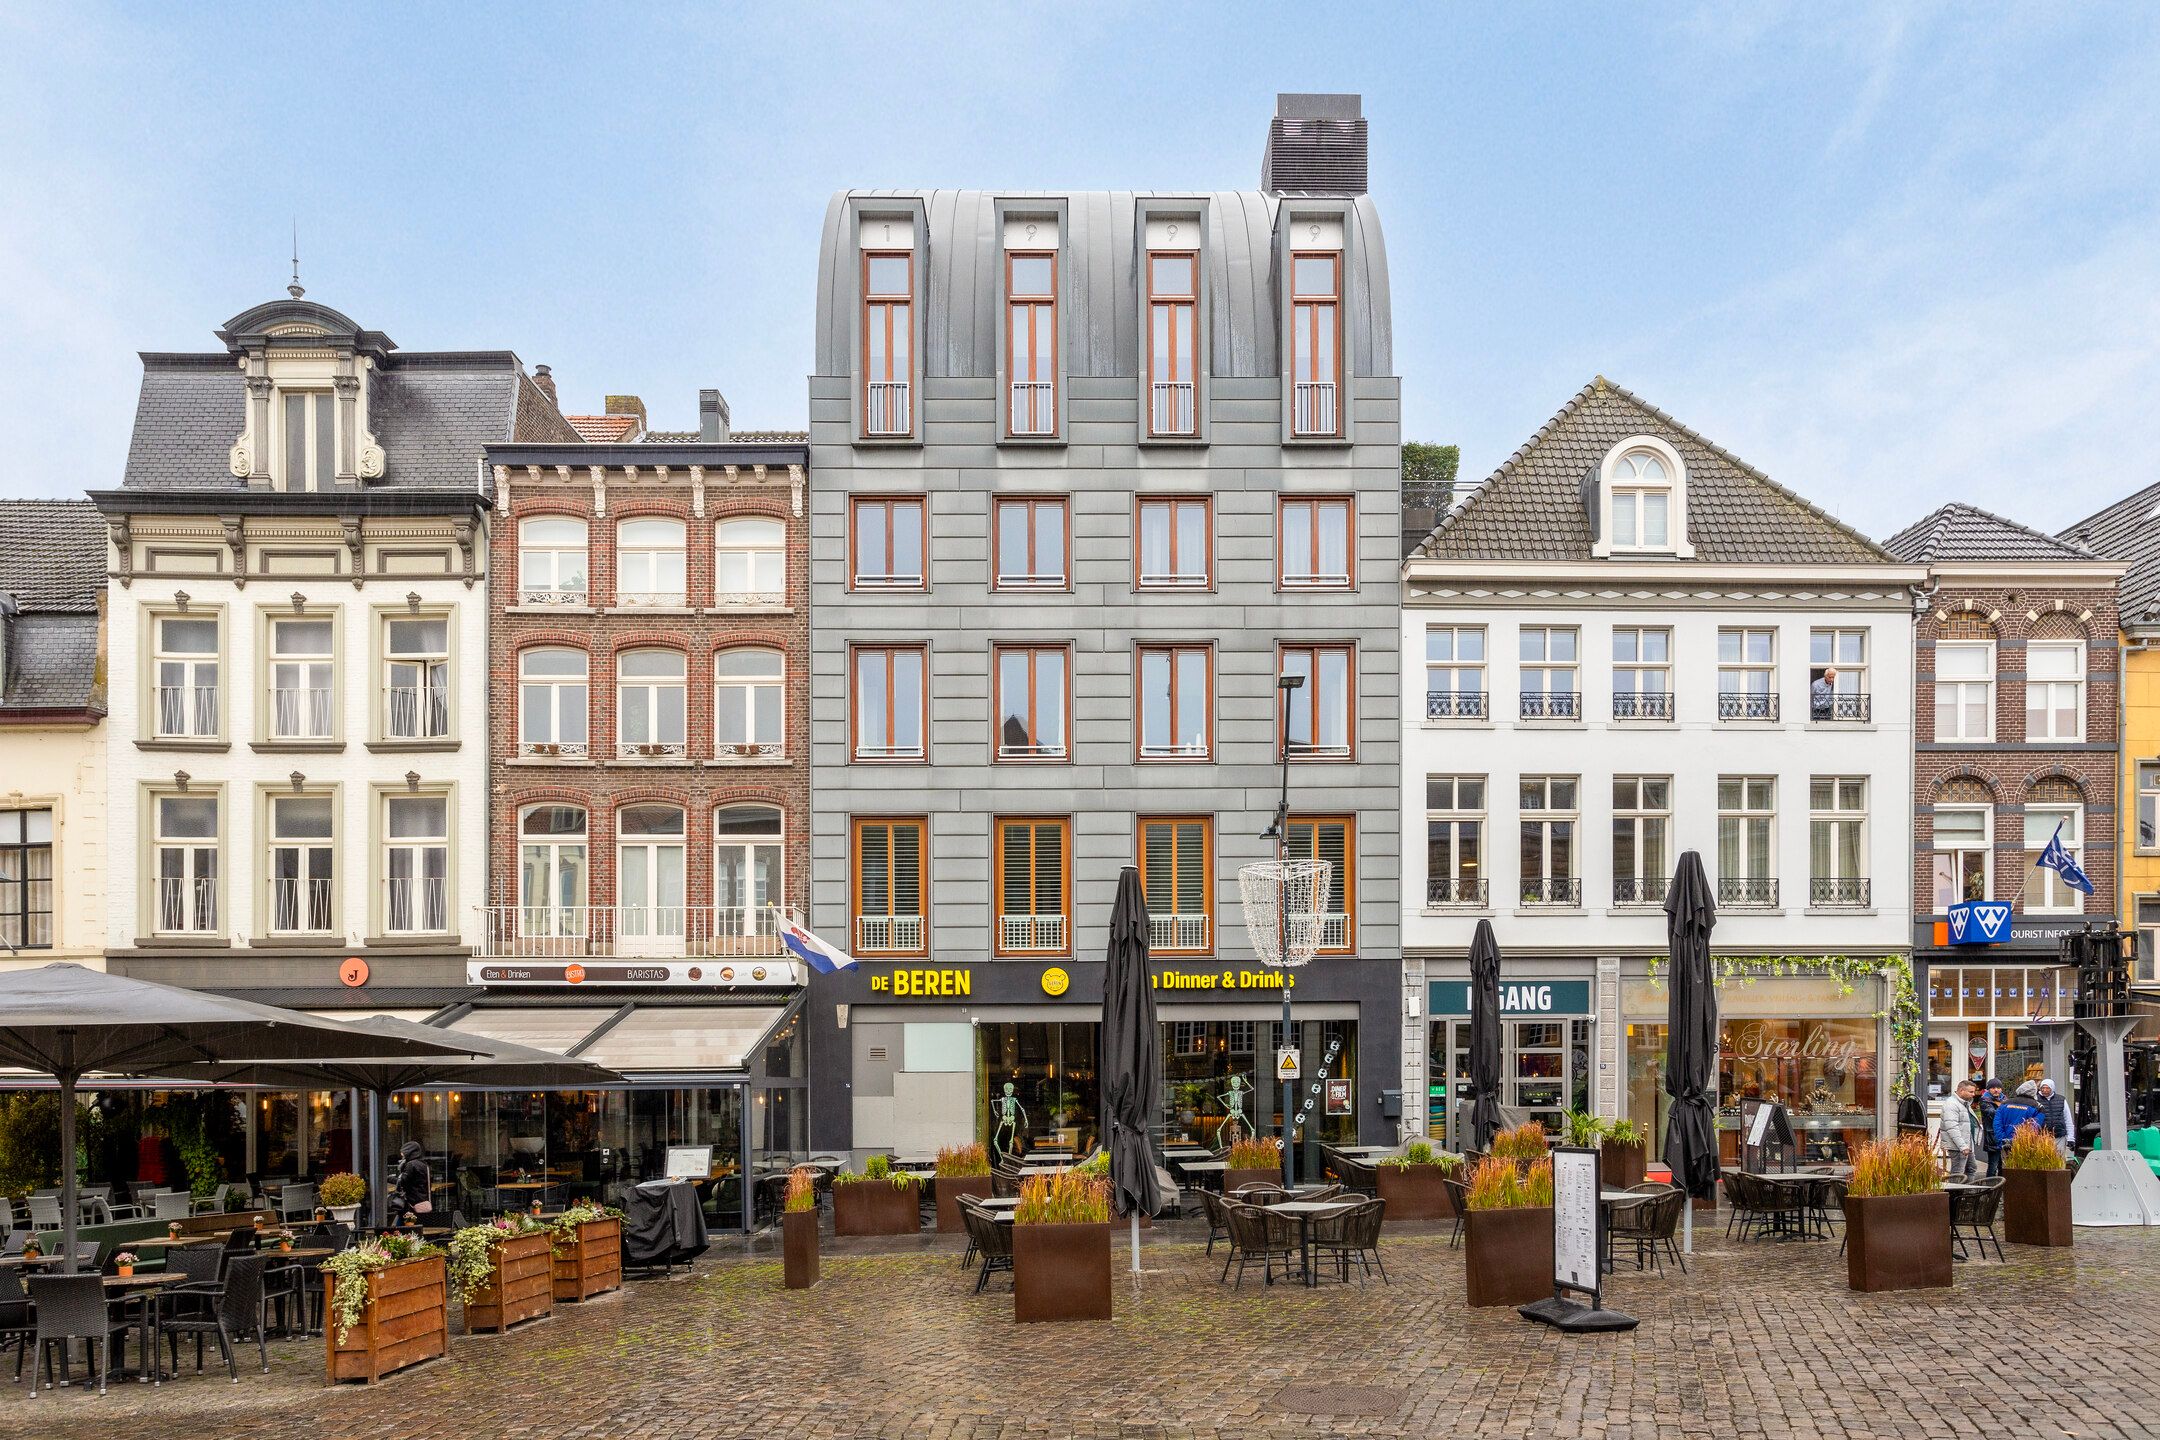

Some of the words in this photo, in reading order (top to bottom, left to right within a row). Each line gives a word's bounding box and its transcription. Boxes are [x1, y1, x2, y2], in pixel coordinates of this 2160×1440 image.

[883, 224, 891, 242] 1
[1025, 224, 1038, 242] 9
[1167, 224, 1179, 242] 9
[1309, 224, 1321, 242] 9
[2010, 929, 2044, 939] OURIST
[347, 969, 359, 982] J
[486, 969, 500, 979] Eten
[500, 969, 507, 979] &
[507, 969, 531, 979] Drinken
[565, 969, 585, 979] BISTRO
[627, 969, 664, 979] BARISTAS
[1163, 971, 1219, 989] Dinner
[1221, 971, 1236, 989] &
[1240, 970, 1295, 989] Drinks
[871, 976, 889, 991] DE
[893, 969, 971, 996] BEREN
[1466, 985, 1552, 1011] IANG
[1734, 1021, 1857, 1070] Sterling
